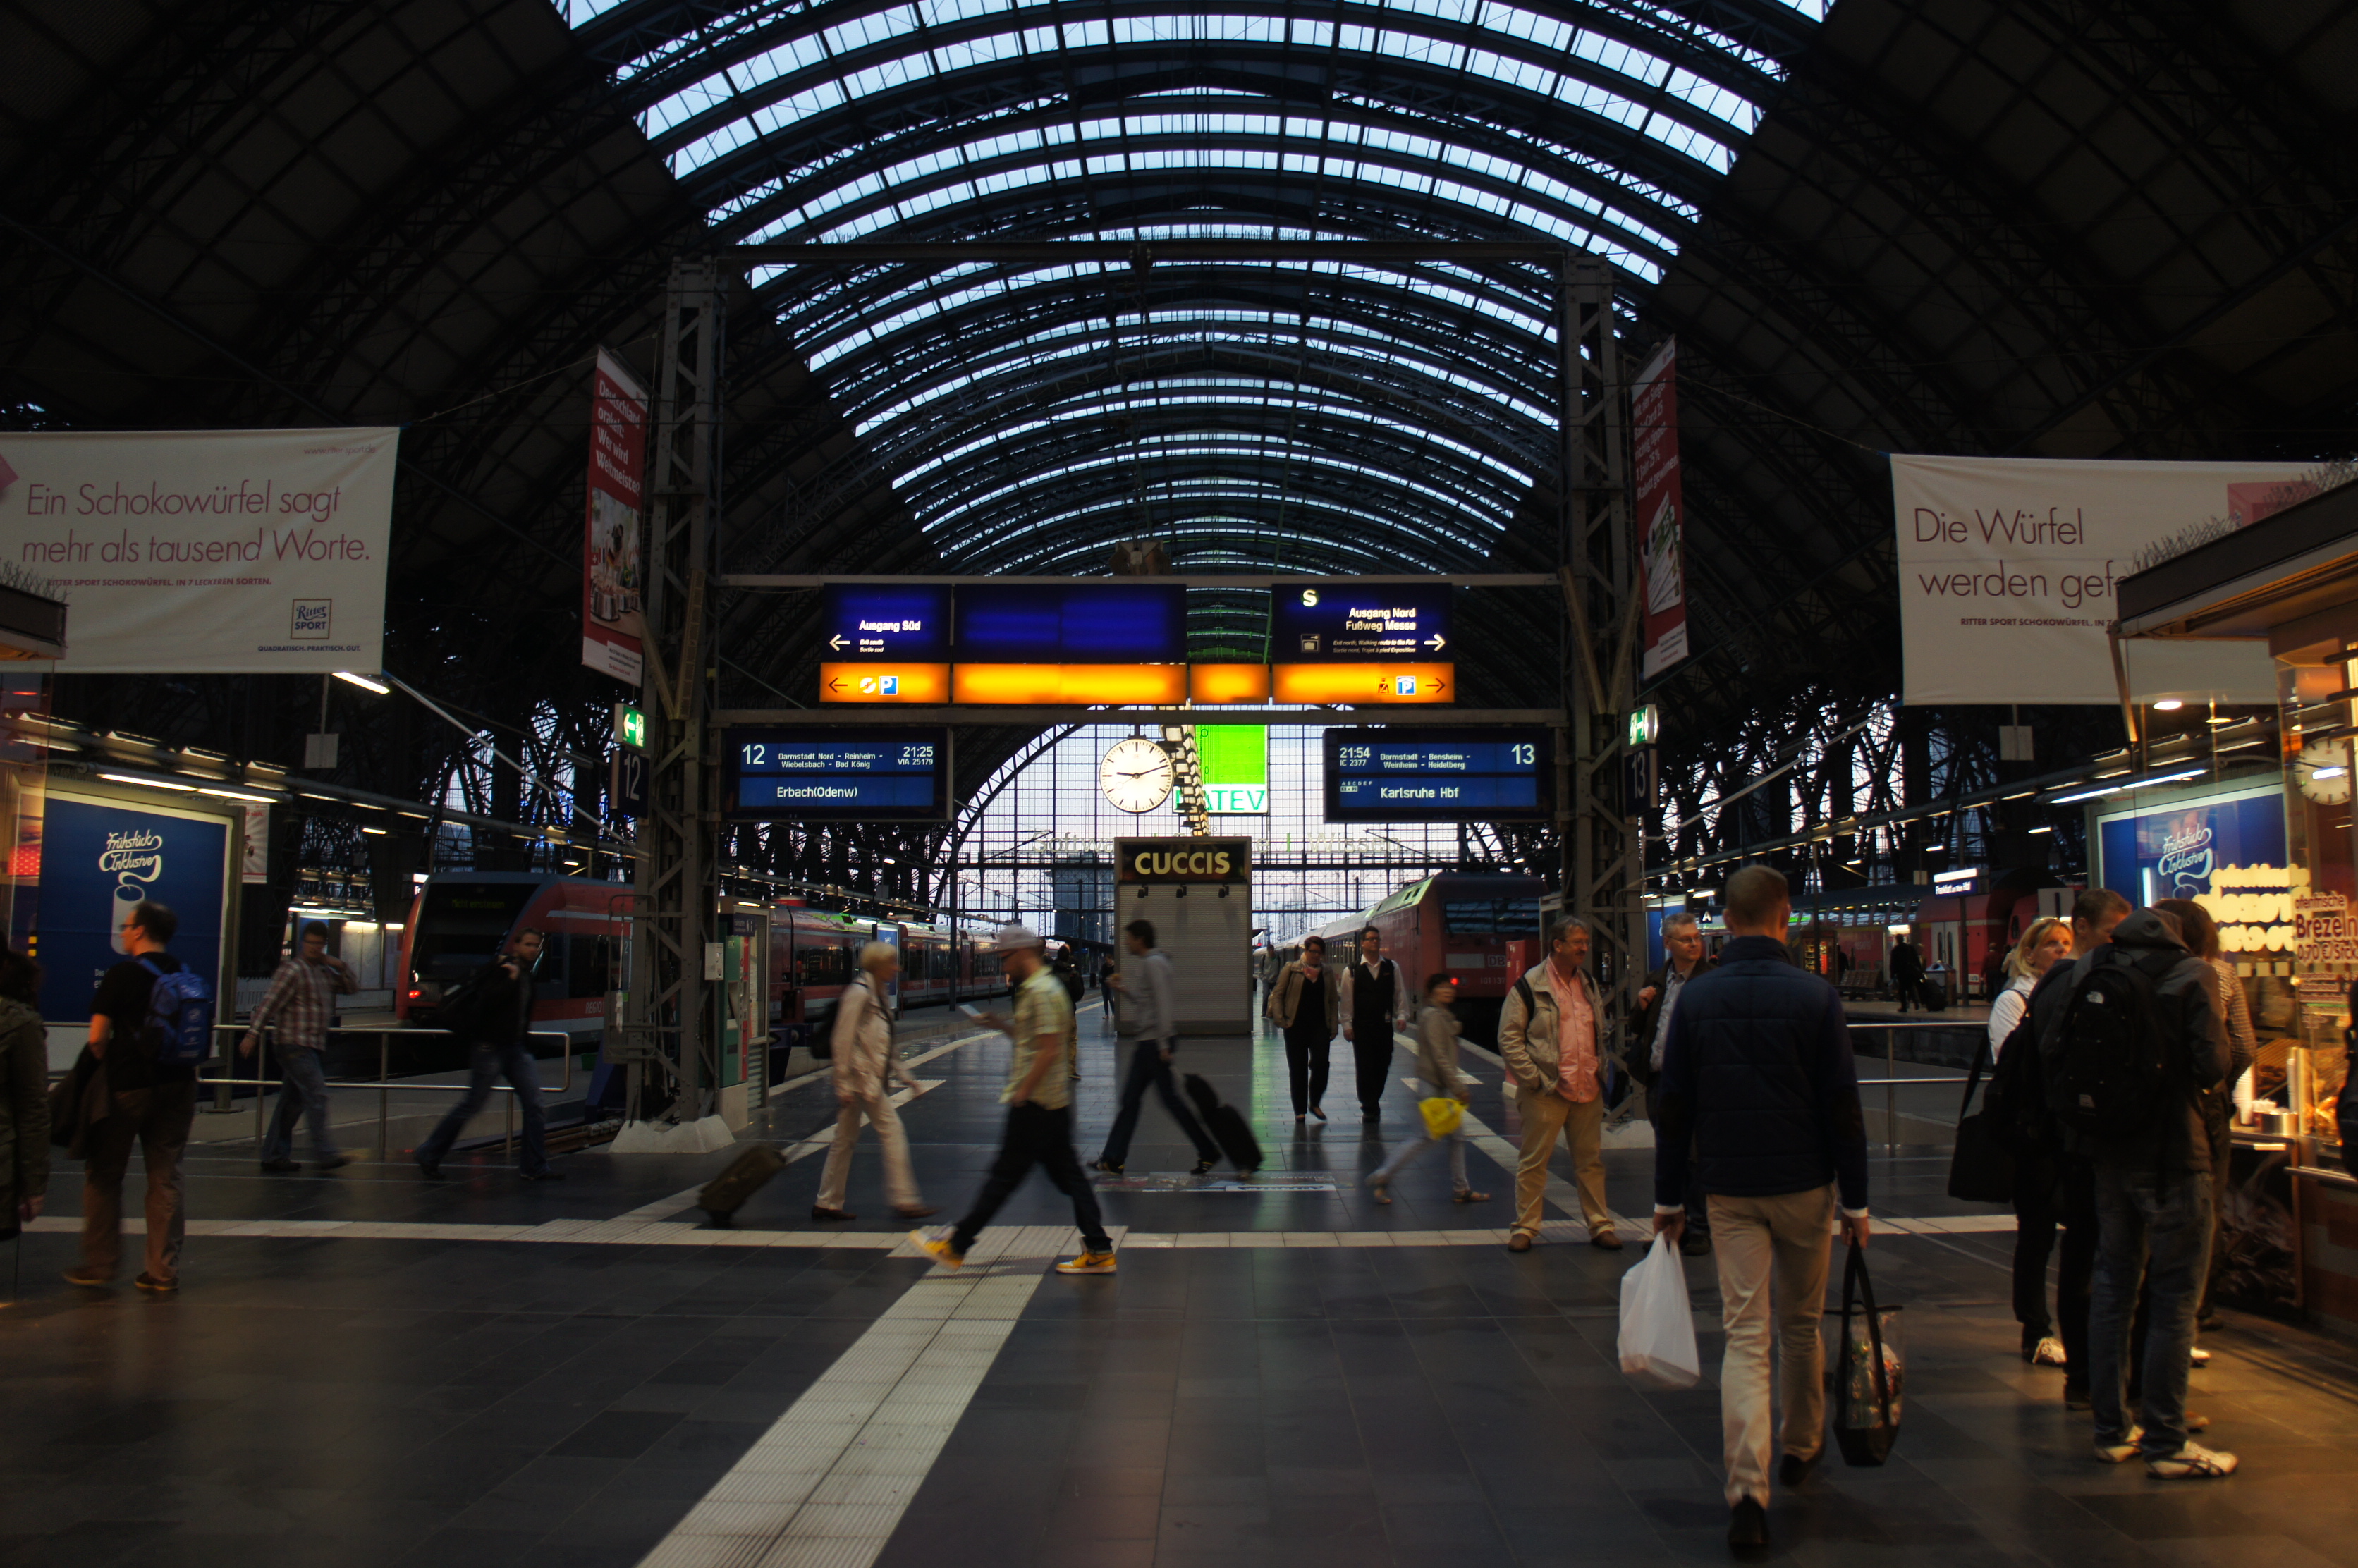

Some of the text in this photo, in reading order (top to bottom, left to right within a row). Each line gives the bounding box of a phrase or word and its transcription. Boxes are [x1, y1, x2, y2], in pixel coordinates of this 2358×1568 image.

[597, 425, 629, 466] Wer wird
[27, 479, 341, 522] Ein Schokowürfel sagt
[1914, 507, 2083, 545] Die Würfel
[22, 527, 371, 563] mehr als tausend Worte.
[102, 577, 174, 586] SCHOKOWÜRFEL.
[195, 577, 234, 586] LECKEREN
[1919, 560, 2127, 609] werden gef
[1302, 589, 1317, 607] S
[295, 605, 327, 621] Ritter
[1349, 608, 1416, 620] Ausgang Nord
[295, 621, 326, 630] SPORT
[859, 620, 921, 632] Ausgang Süd
[1345, 620, 1416, 632] Fußweg Messe
[1960, 618, 1987, 626] RITTER
[1989, 618, 2017, 626] SPORT
[2018, 617, 2094, 627] SCHOKOWÜRFEL.
[2094, 618, 2106, 627] IN
[743, 745, 765, 764] 12
[903, 746, 933, 757] 21:25
[1340, 747, 1370, 759] 21:54
[1511, 744, 1535, 765] 13
[851, 761, 871, 769] König
[1428, 761, 1465, 770] Heidelberg
[624, 753, 641, 801] 12
[1631, 751, 1647, 799] 13
[777, 786, 858, 798] Erbach(Odenw)
[1381, 787, 1459, 798] Karlsruhe Hbf
[106, 829, 162, 850] Frühstück
[2162, 823, 2212, 854] Frühstück
[1135, 850, 1230, 875] CUCCIS
[1702, 910, 1711, 922] A
[2296, 914, 2358, 938] Brezeln
[1489, 955, 1505, 966] DB
[585, 1001, 602, 1014] REGIO
